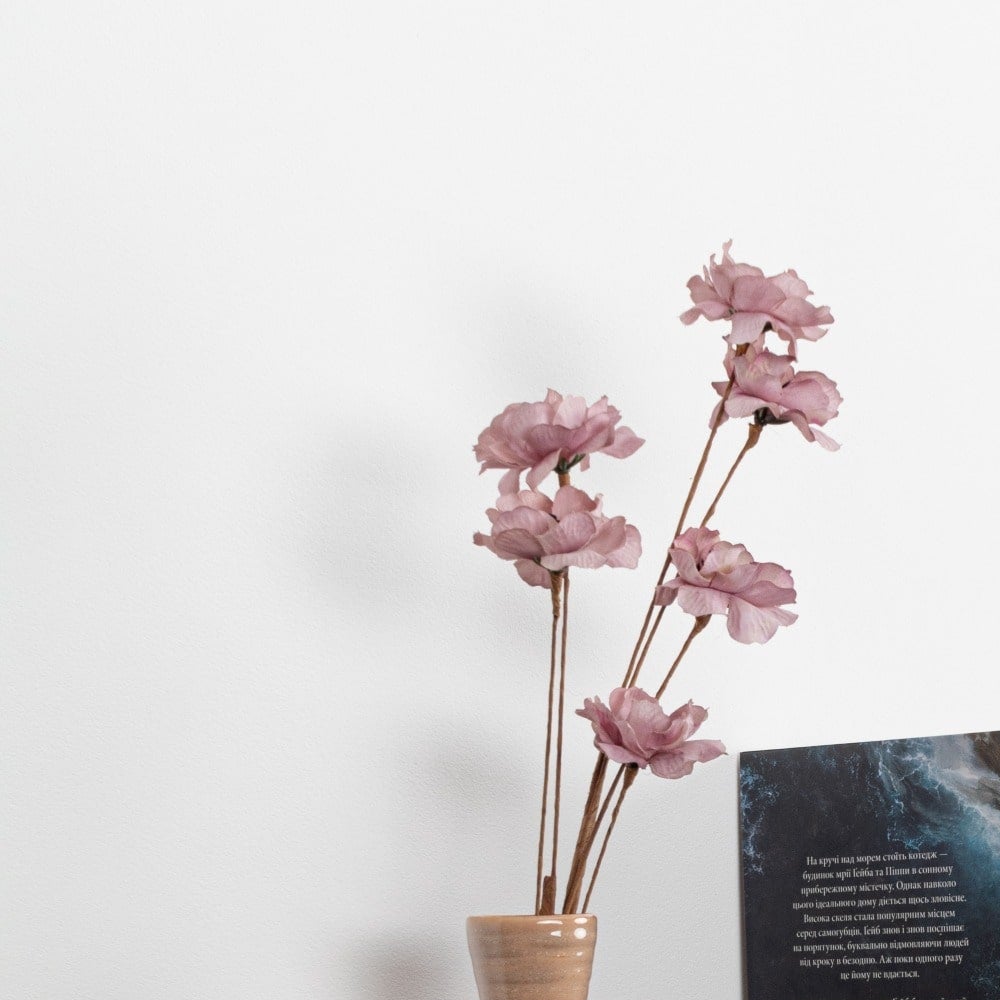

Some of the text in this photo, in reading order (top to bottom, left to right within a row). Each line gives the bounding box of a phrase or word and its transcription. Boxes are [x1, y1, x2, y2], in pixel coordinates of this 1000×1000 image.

[806, 856, 817, 866] На
[840, 856, 854, 866] над
[793, 944, 802, 952] на
[799, 956, 811, 968] від
[879, 954, 892, 964] Аж
[840, 972, 849, 981] це
[872, 971, 881, 979] не
